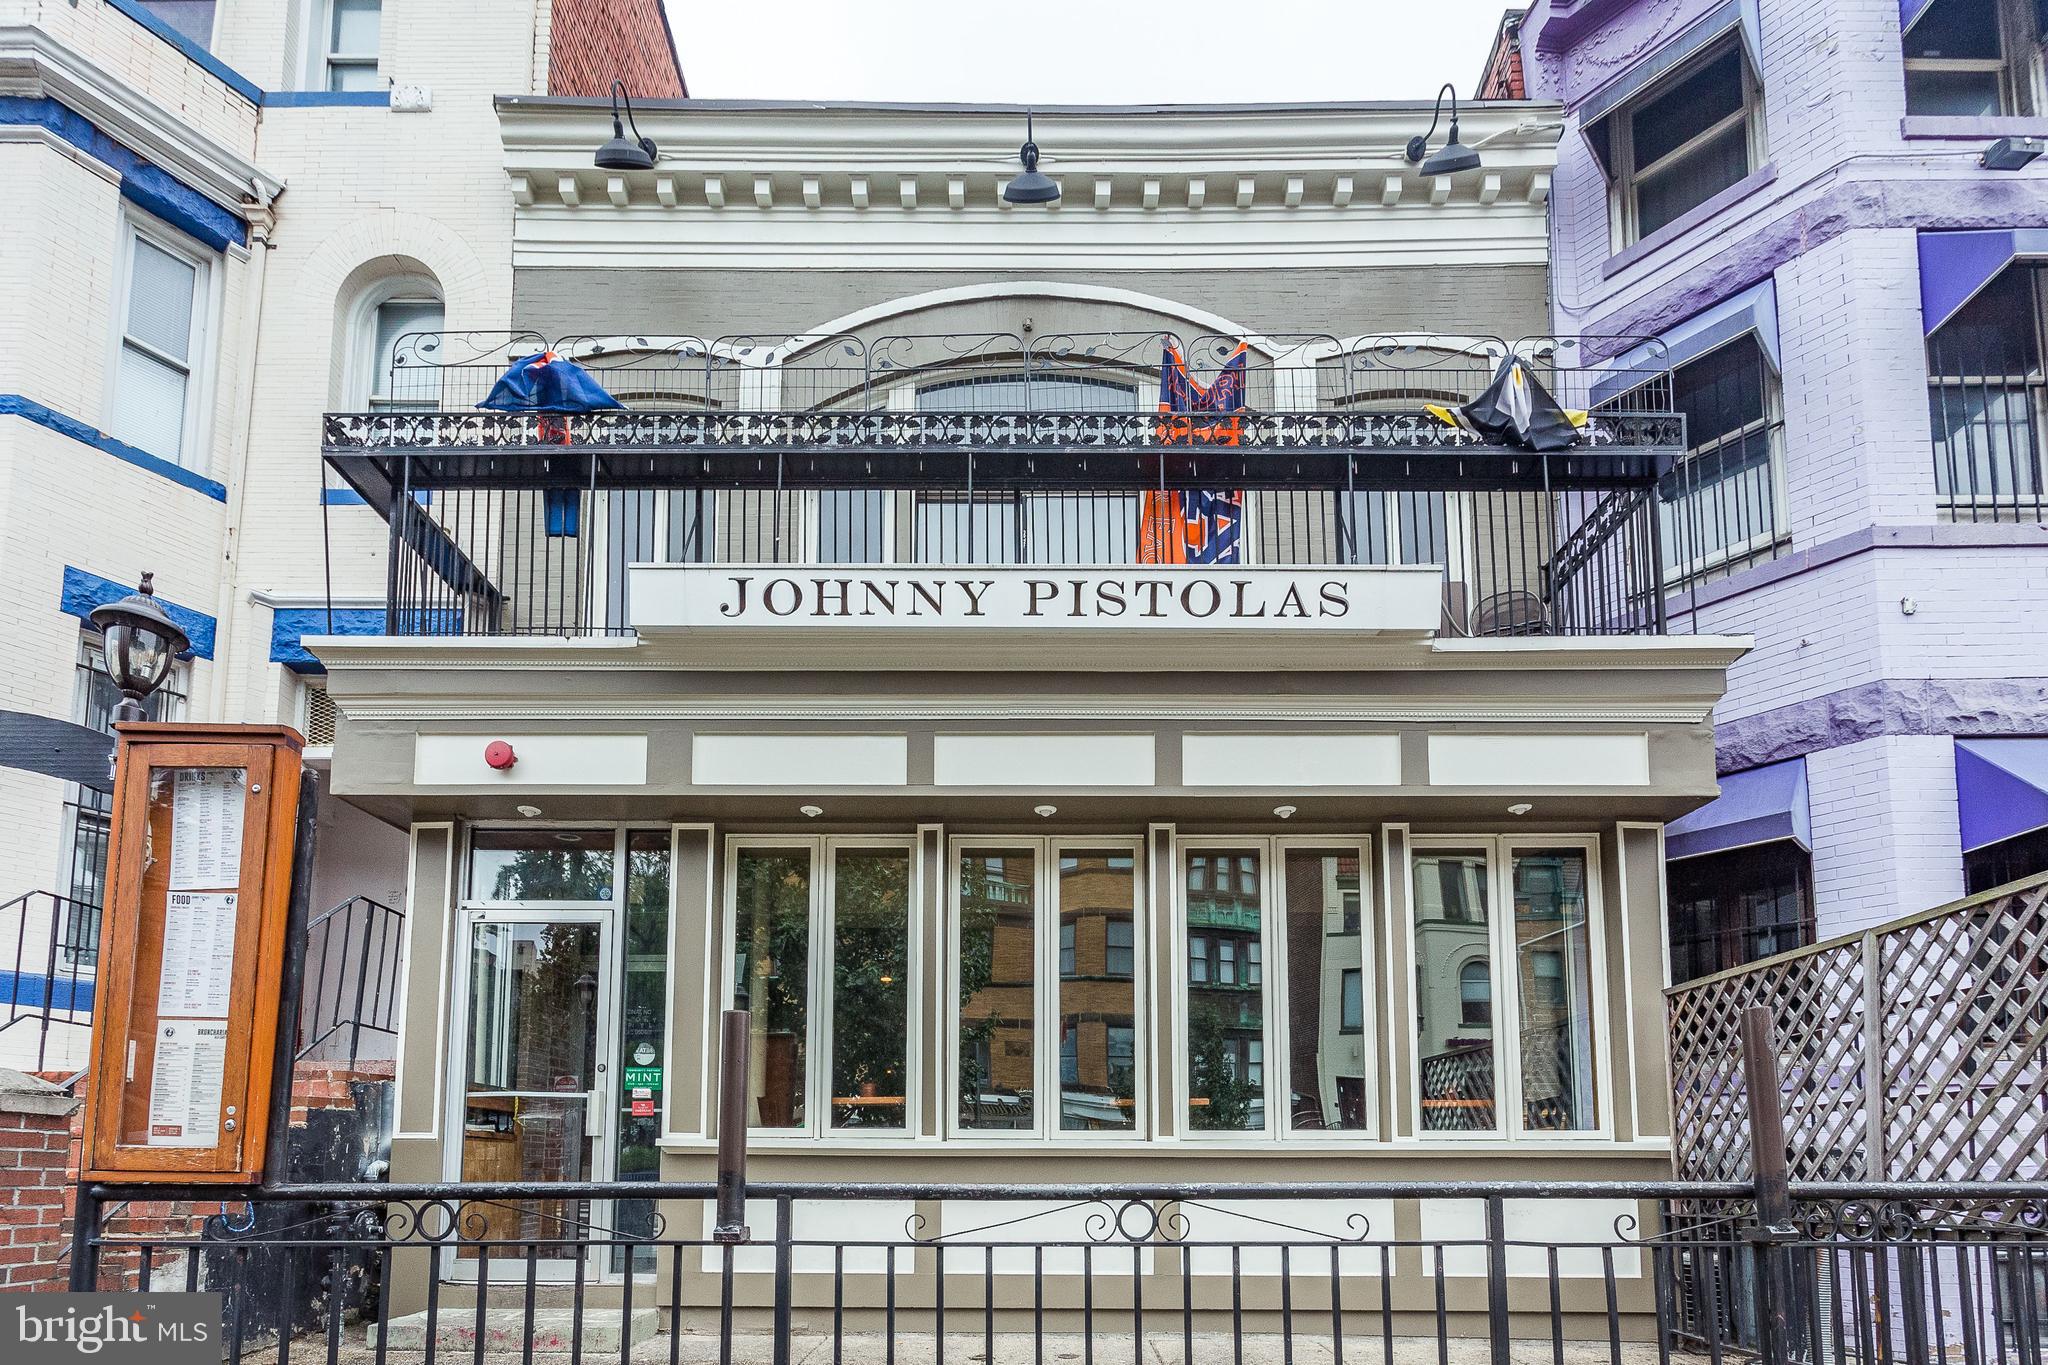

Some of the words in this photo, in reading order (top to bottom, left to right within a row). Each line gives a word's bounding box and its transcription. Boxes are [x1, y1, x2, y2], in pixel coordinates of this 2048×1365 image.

[720, 578, 994, 617] JOHNNY
[1023, 580, 1348, 617] PISTOLAS
[179, 771, 206, 781] DRINKS
[172, 895, 191, 905] FOOD
[625, 1073, 662, 1082] MINT
